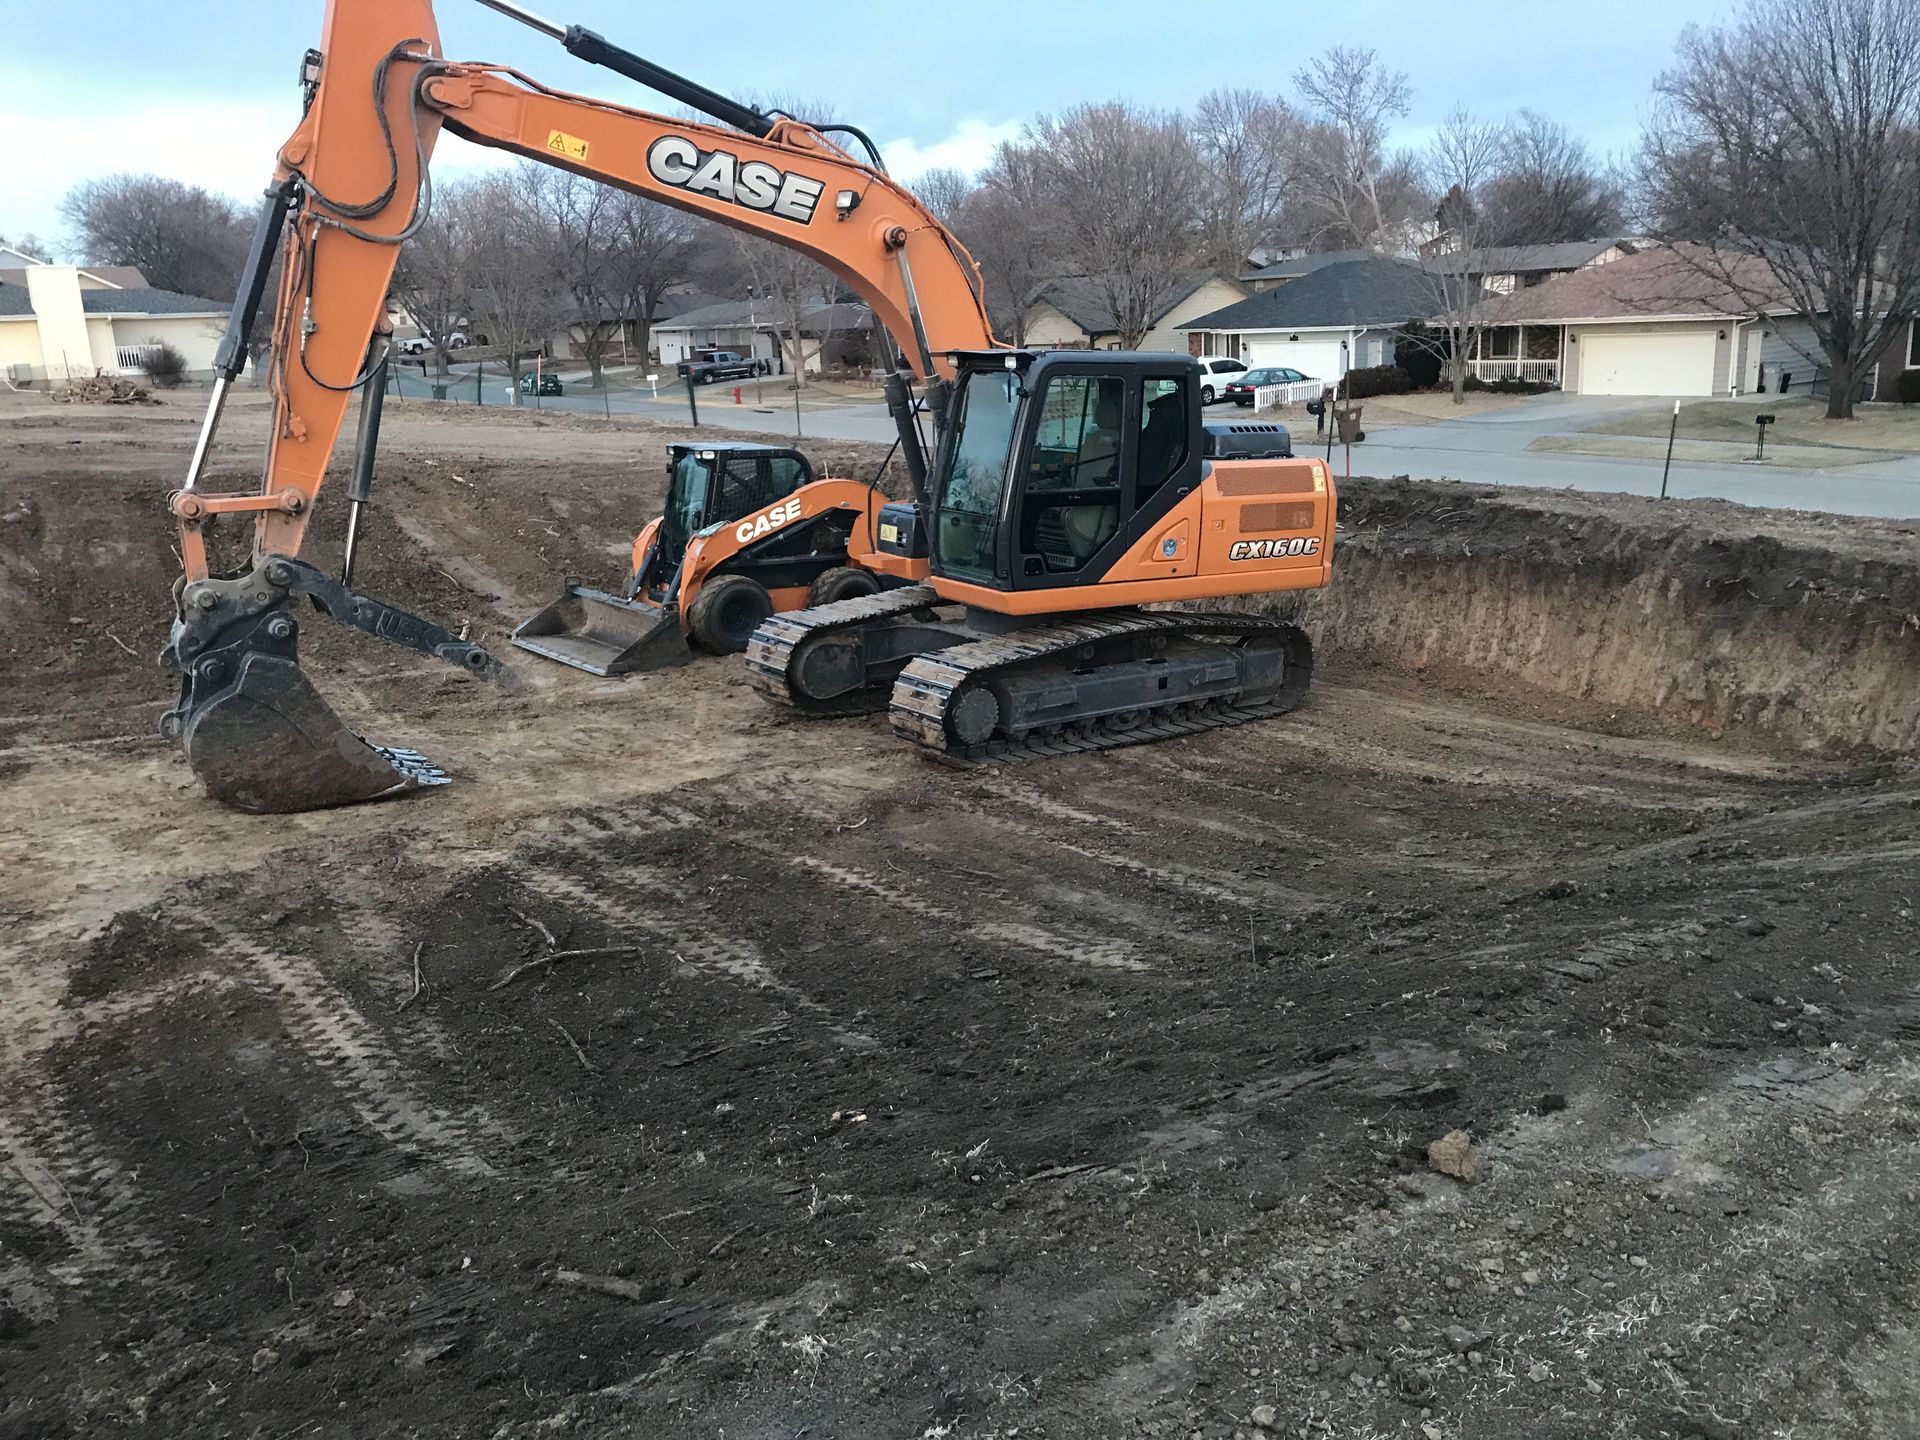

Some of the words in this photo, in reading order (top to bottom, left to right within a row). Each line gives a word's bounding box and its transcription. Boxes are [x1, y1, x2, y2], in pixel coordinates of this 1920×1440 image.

[648, 136, 824, 224] CASE
[736, 498, 801, 543] CASE
[1230, 537, 1320, 561] CX160C
